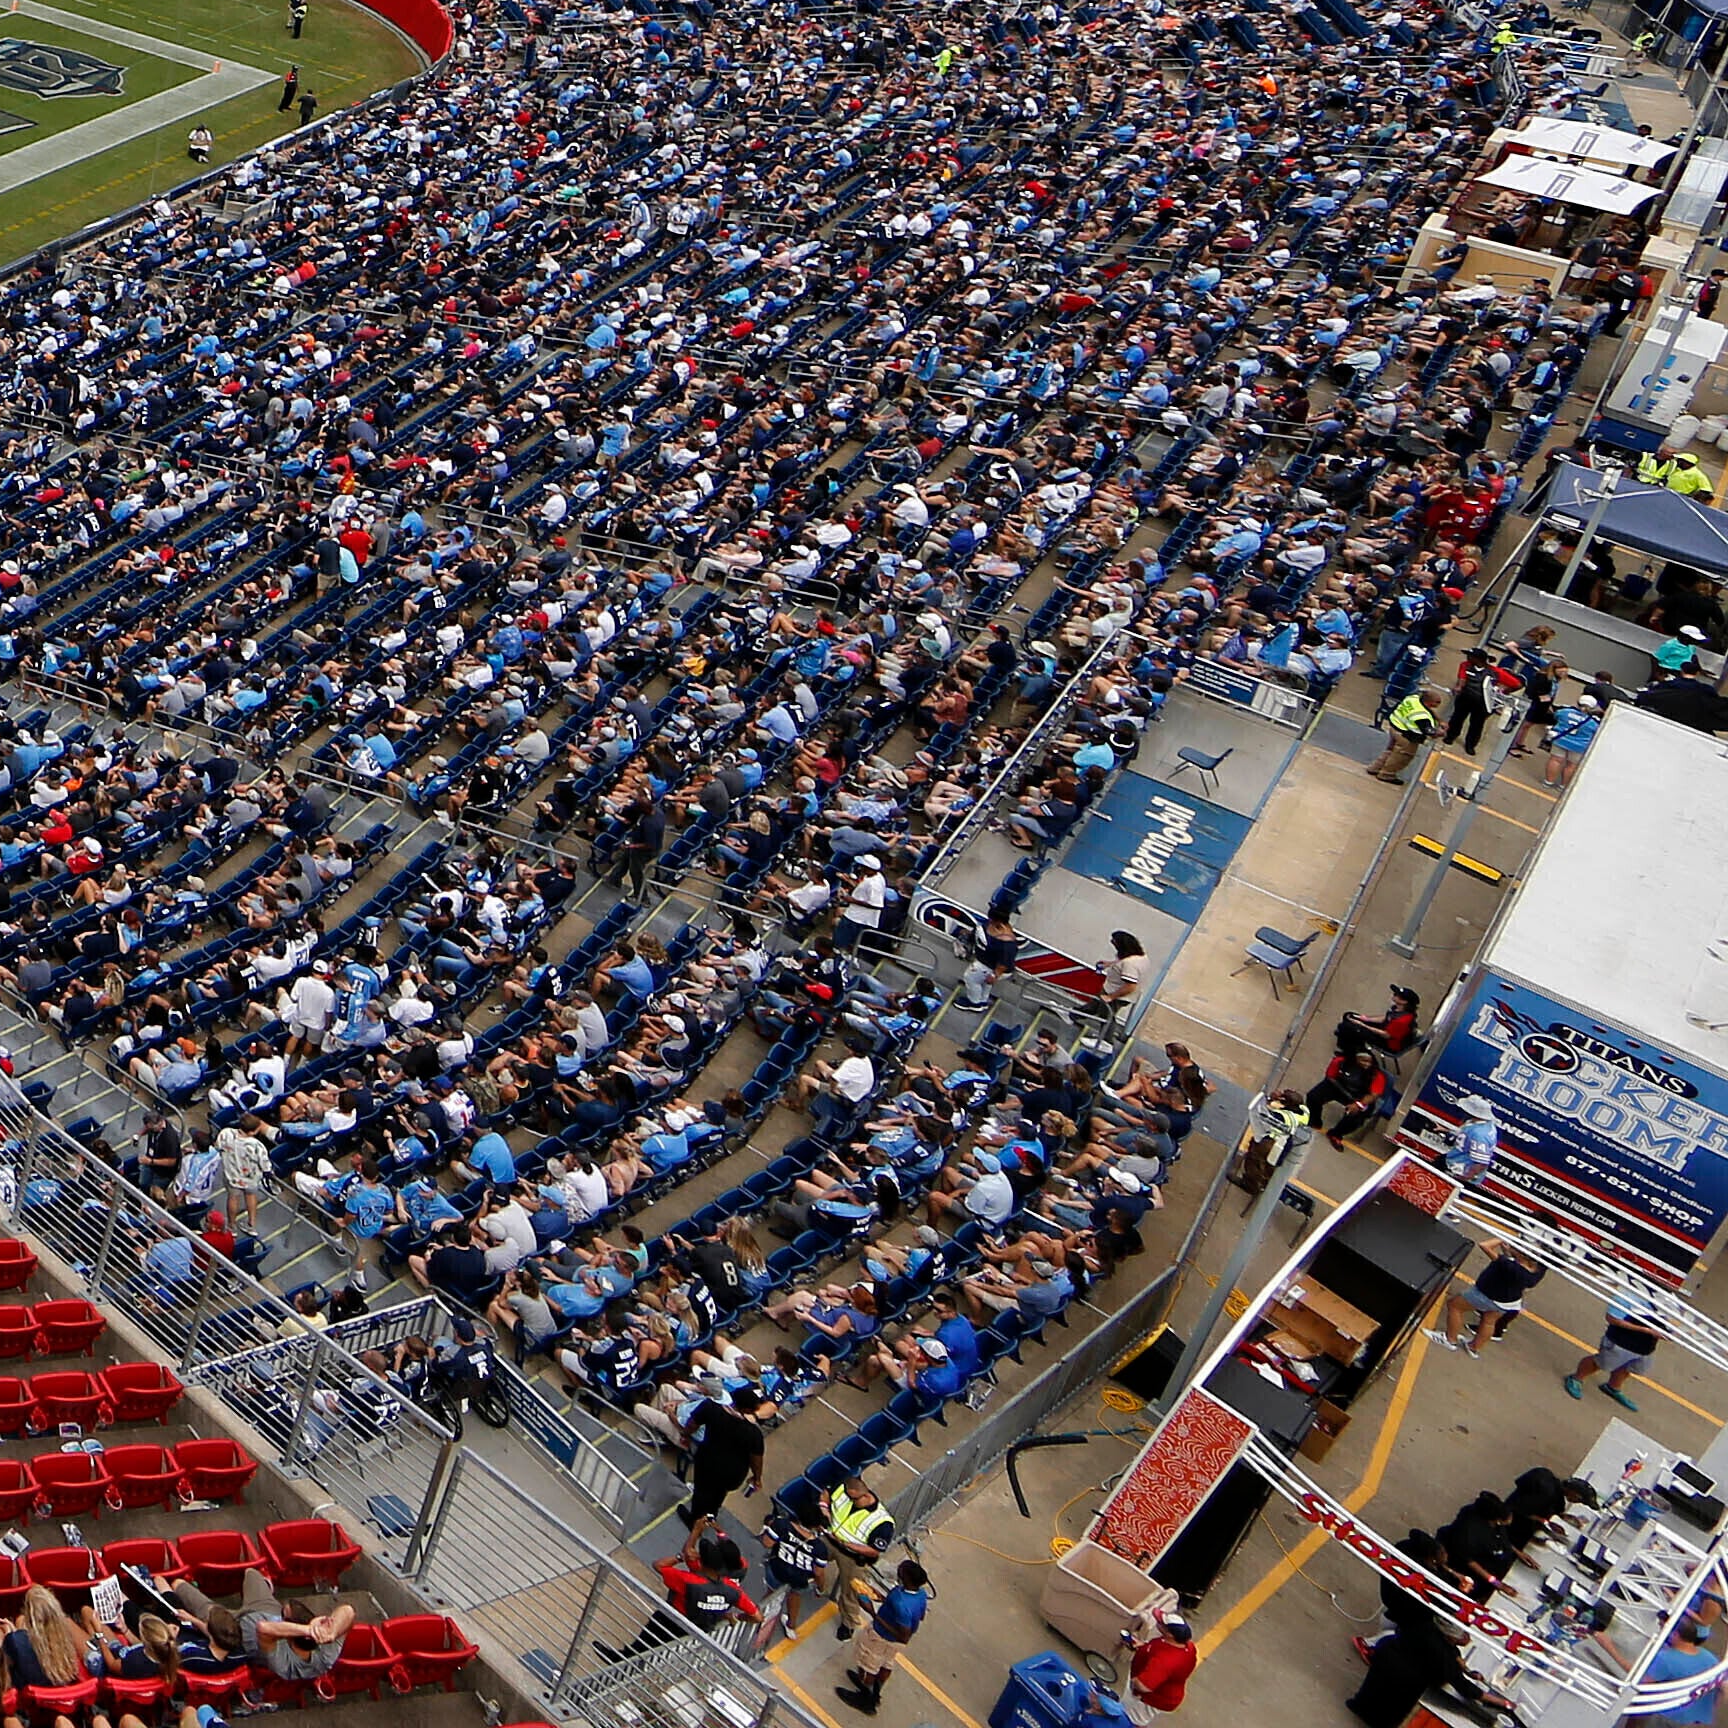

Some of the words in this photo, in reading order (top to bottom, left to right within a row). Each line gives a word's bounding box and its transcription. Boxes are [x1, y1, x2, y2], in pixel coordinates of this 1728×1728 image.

[1121, 795, 1197, 895] permobil
[1496, 1051, 1687, 1169] ROOM
[1558, 1021, 1687, 1098] TITANS
[1468, 1071, 1515, 1099] OFFICIAL
[1514, 1094, 1551, 1117] STORE
[1550, 1112, 1568, 1125] OF
[1568, 1121, 1589, 1136] THE
[1590, 1132, 1656, 1169] TENNESSEE
[1657, 1165, 1696, 1189] TITANS
[1515, 1114, 1549, 1134] Locker
[1550, 1130, 1580, 1149] Room
[1579, 1144, 1619, 1169] located
[1631, 1170, 1669, 1194] Nissan
[1669, 1189, 1714, 1217] Stadium
[723, 1260, 738, 1288] 8
